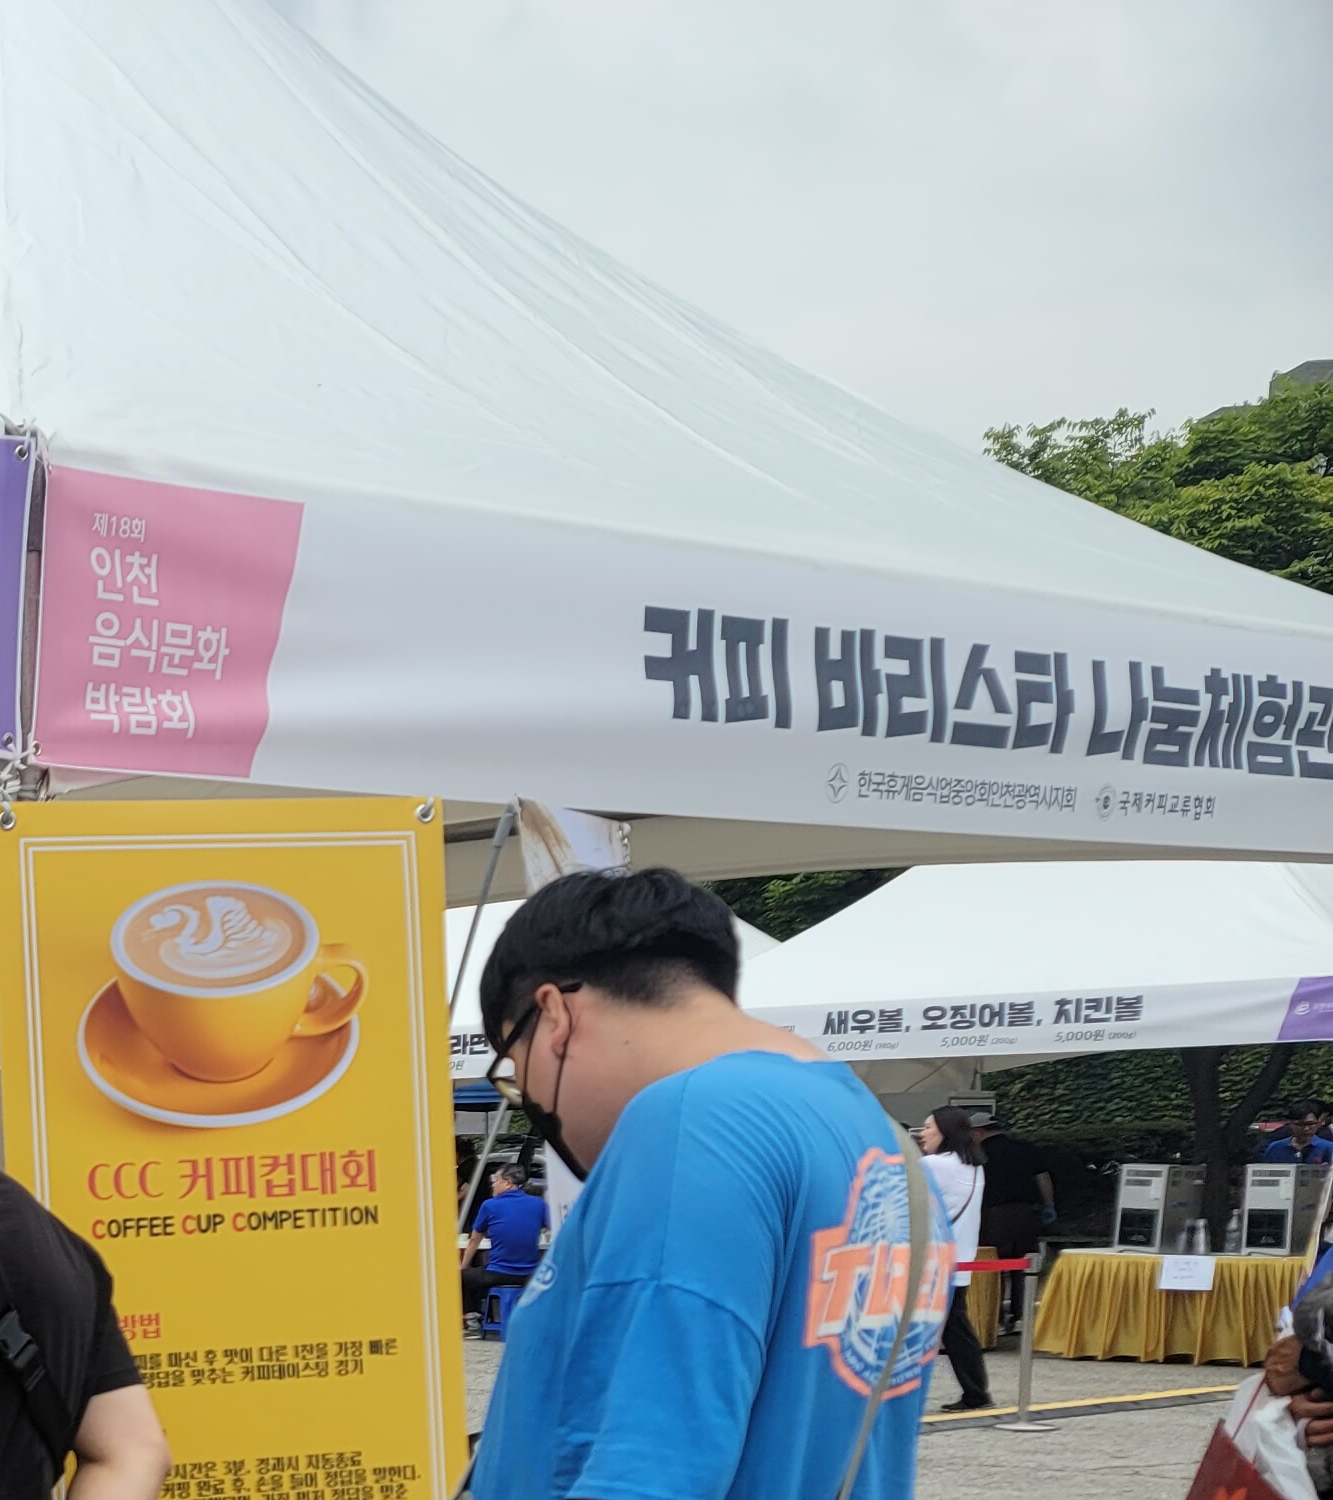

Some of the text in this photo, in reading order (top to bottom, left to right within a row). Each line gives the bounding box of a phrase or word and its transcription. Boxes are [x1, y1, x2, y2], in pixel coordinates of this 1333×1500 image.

[92, 511, 147, 543] 제18회
[90, 546, 160, 607] 인천
[89, 612, 230, 681] 음식문화
[643, 605, 791, 730] 커피
[814, 625, 1074, 755] 바리스타
[85, 683, 195, 739] 박람회
[858, 770, 1077, 813] 한국휴게음식업중앙회인천광역시지회
[1119, 791, 1216, 821] 국제커피교류협회
[822, 995, 1144, 1035] 새우볼, 오징어볼, 치킨볼
[827, 1039, 874, 1052] 6,000원
[940, 1034, 990, 1048] 5,000원
[1054, 1029, 1106, 1043] 5,000원
[88, 1149, 377, 1200] CCC 커피컵대회
[92, 1205, 379, 1240] COFFEE CUP COMPETITION
[168, 1350, 198, 1368] 마신
[204, 1349, 218, 1366] 후
[222, 1346, 253, 1366] 맛이
[259, 1344, 288, 1362] 다른
[334, 1340, 363, 1358] 가장
[369, 1338, 398, 1356] 빠른
[190, 1358, 364, 1386] 맞추는 커피테이스팅 경기
[256, 1455, 300, 1475] 경과시
[324, 1468, 367, 1488] 정답을
